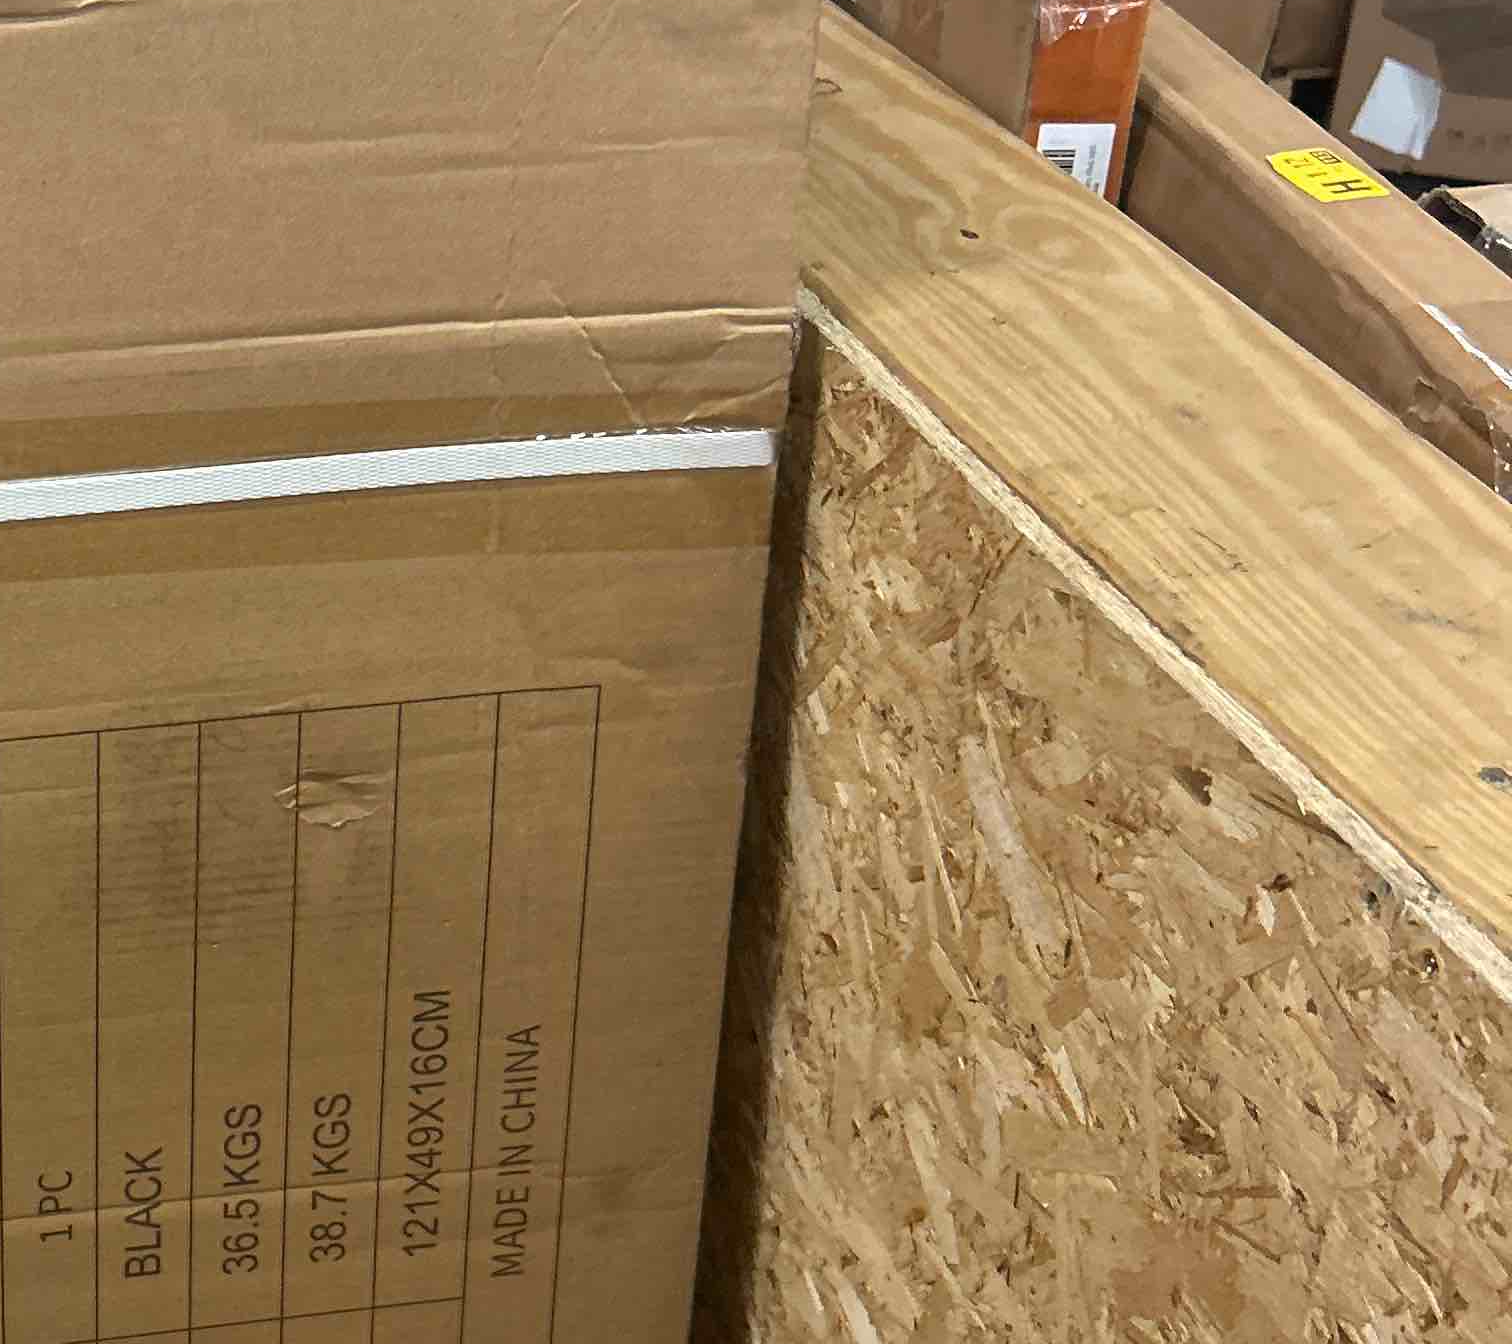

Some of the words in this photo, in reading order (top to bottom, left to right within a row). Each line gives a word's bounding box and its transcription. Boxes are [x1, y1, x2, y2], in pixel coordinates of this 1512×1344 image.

[500, 1024, 541, 1134] CHINA
[223, 1103, 261, 1188] KGS
[312, 1092, 351, 1176] KGS
[402, 990, 450, 1256] 121X49X16CM
[498, 1144, 533, 1176] IN
[38, 1170, 72, 1215] PC
[41, 1223, 72, 1242] 1
[124, 1146, 162, 1278] BLACK
[309, 1190, 347, 1263] 38.7
[491, 1186, 531, 1278] MADE
[222, 1198, 259, 1275] 36.5
